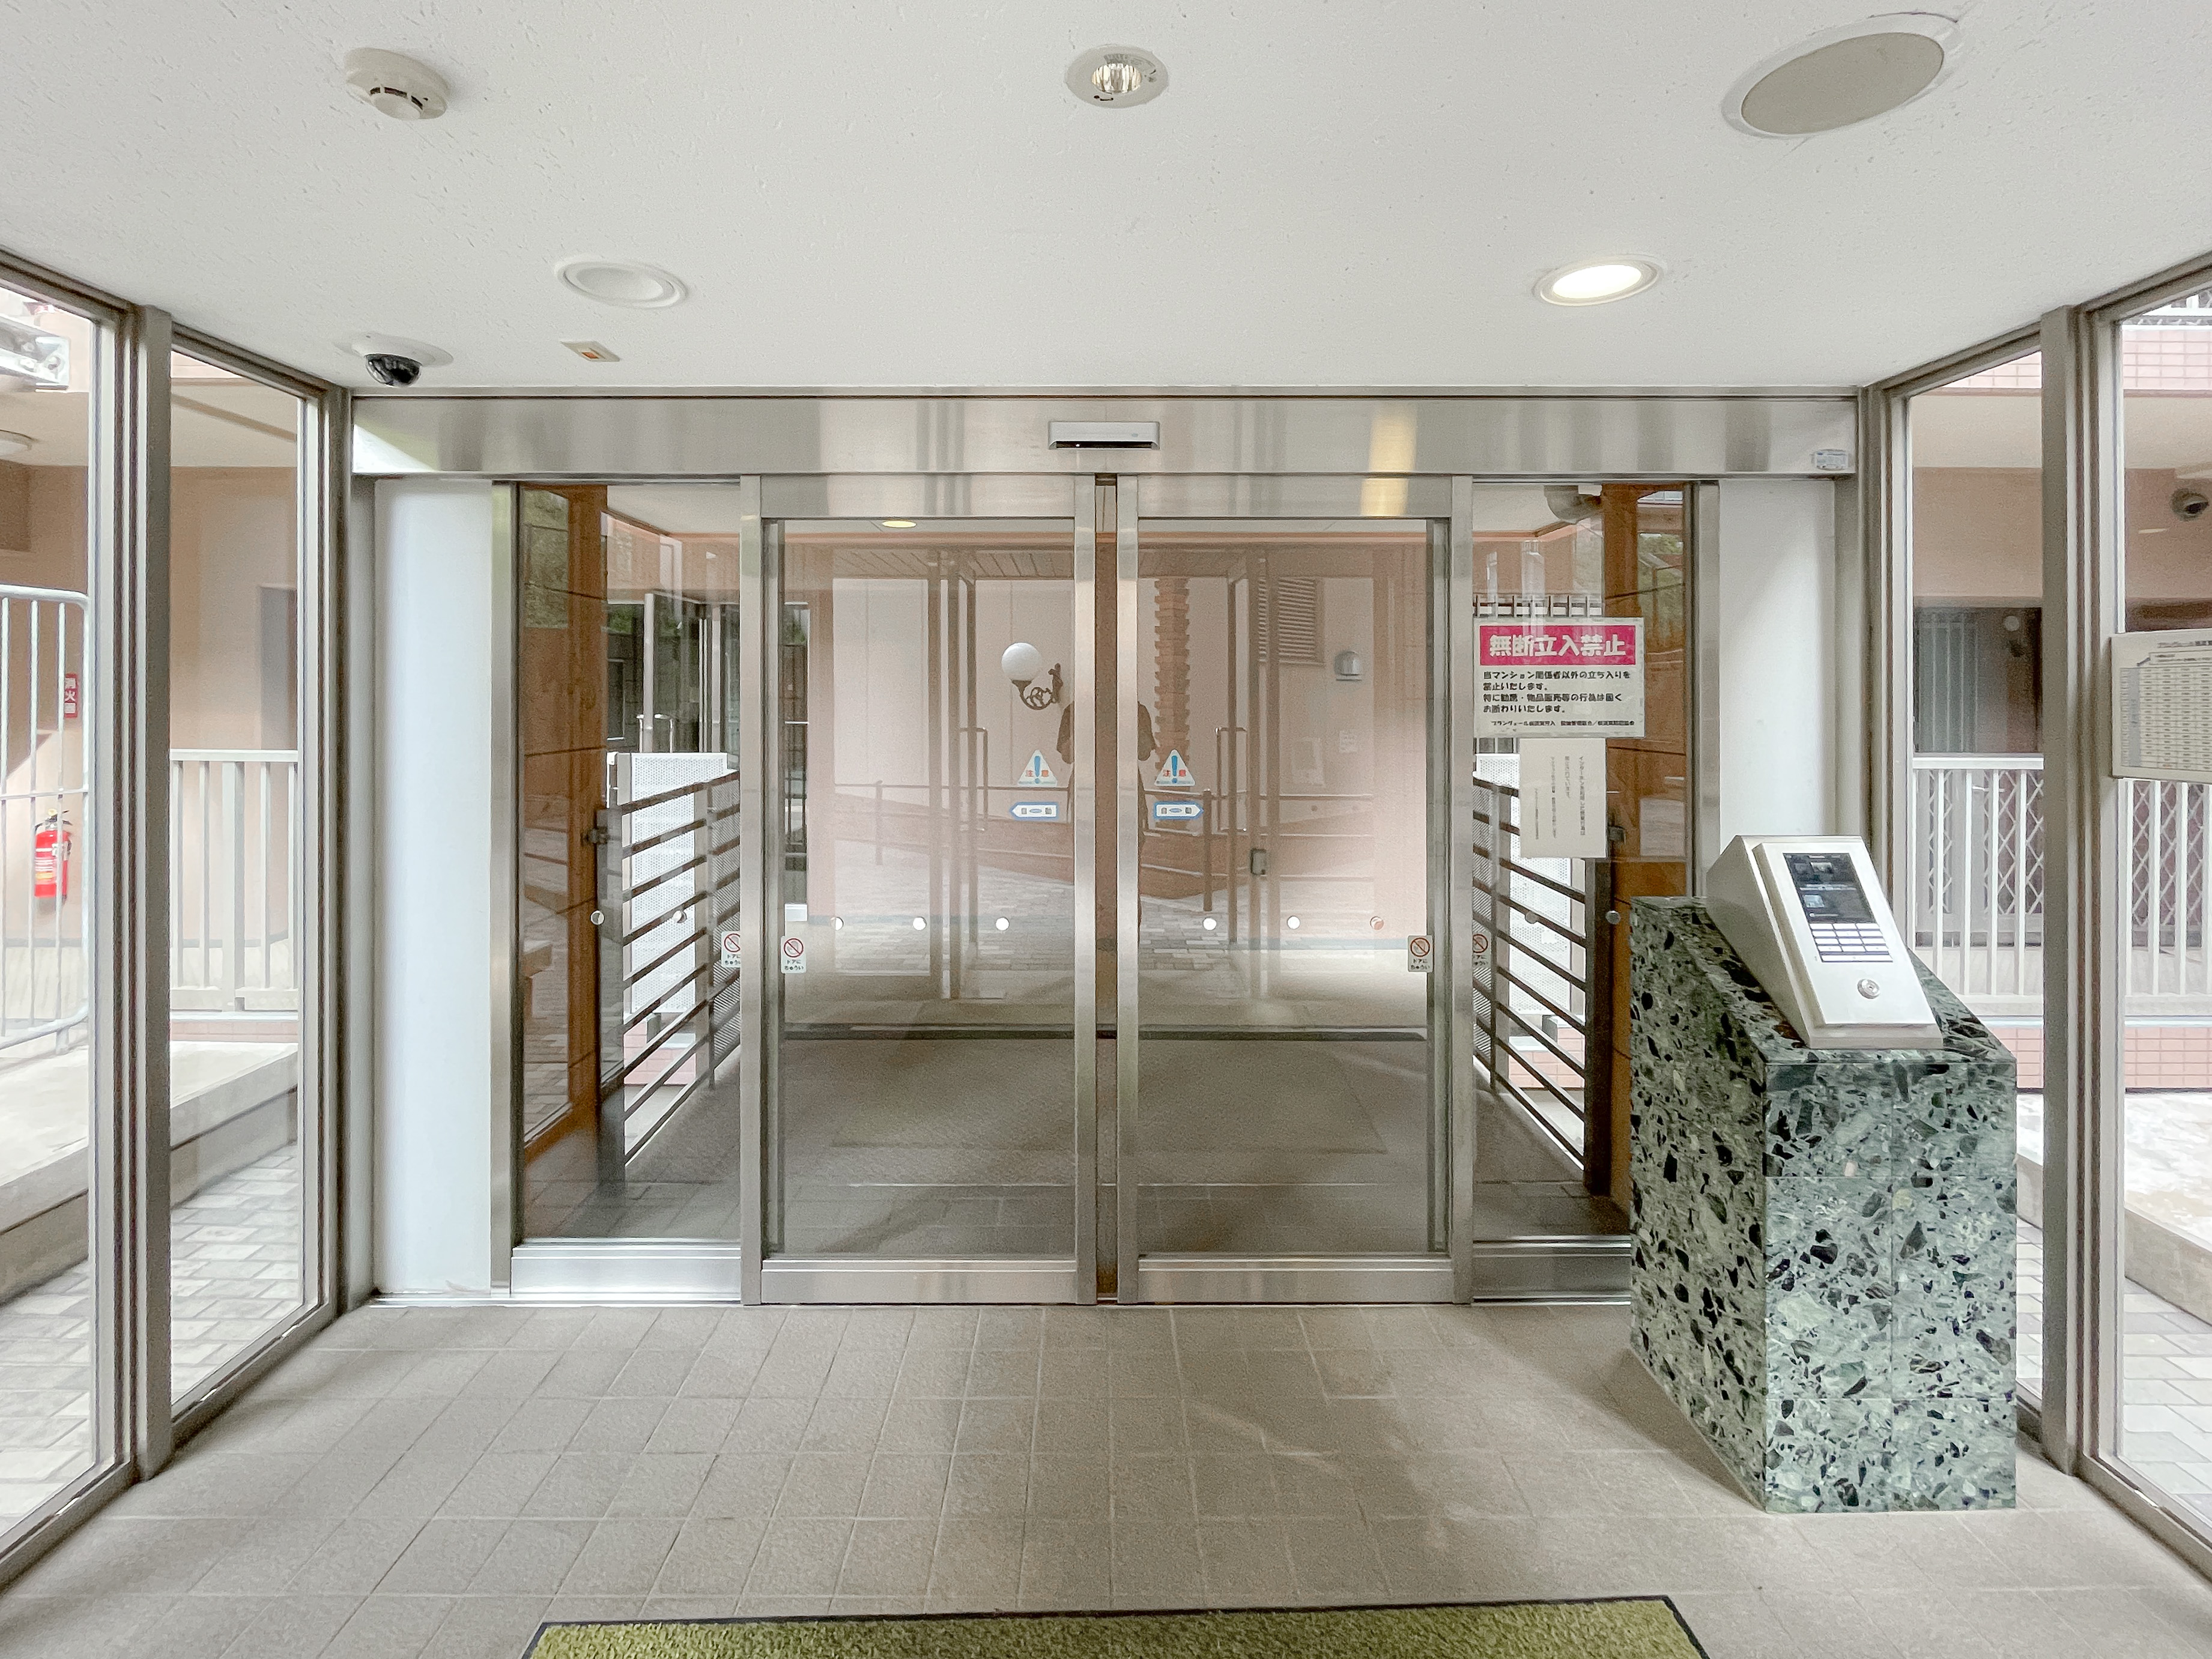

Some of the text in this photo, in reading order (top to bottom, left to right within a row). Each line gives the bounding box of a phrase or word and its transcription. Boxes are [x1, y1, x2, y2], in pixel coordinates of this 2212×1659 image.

[1489, 634, 1626, 657] 無断立入禁止
[1483, 705, 1566, 714] お断わりいたします。
